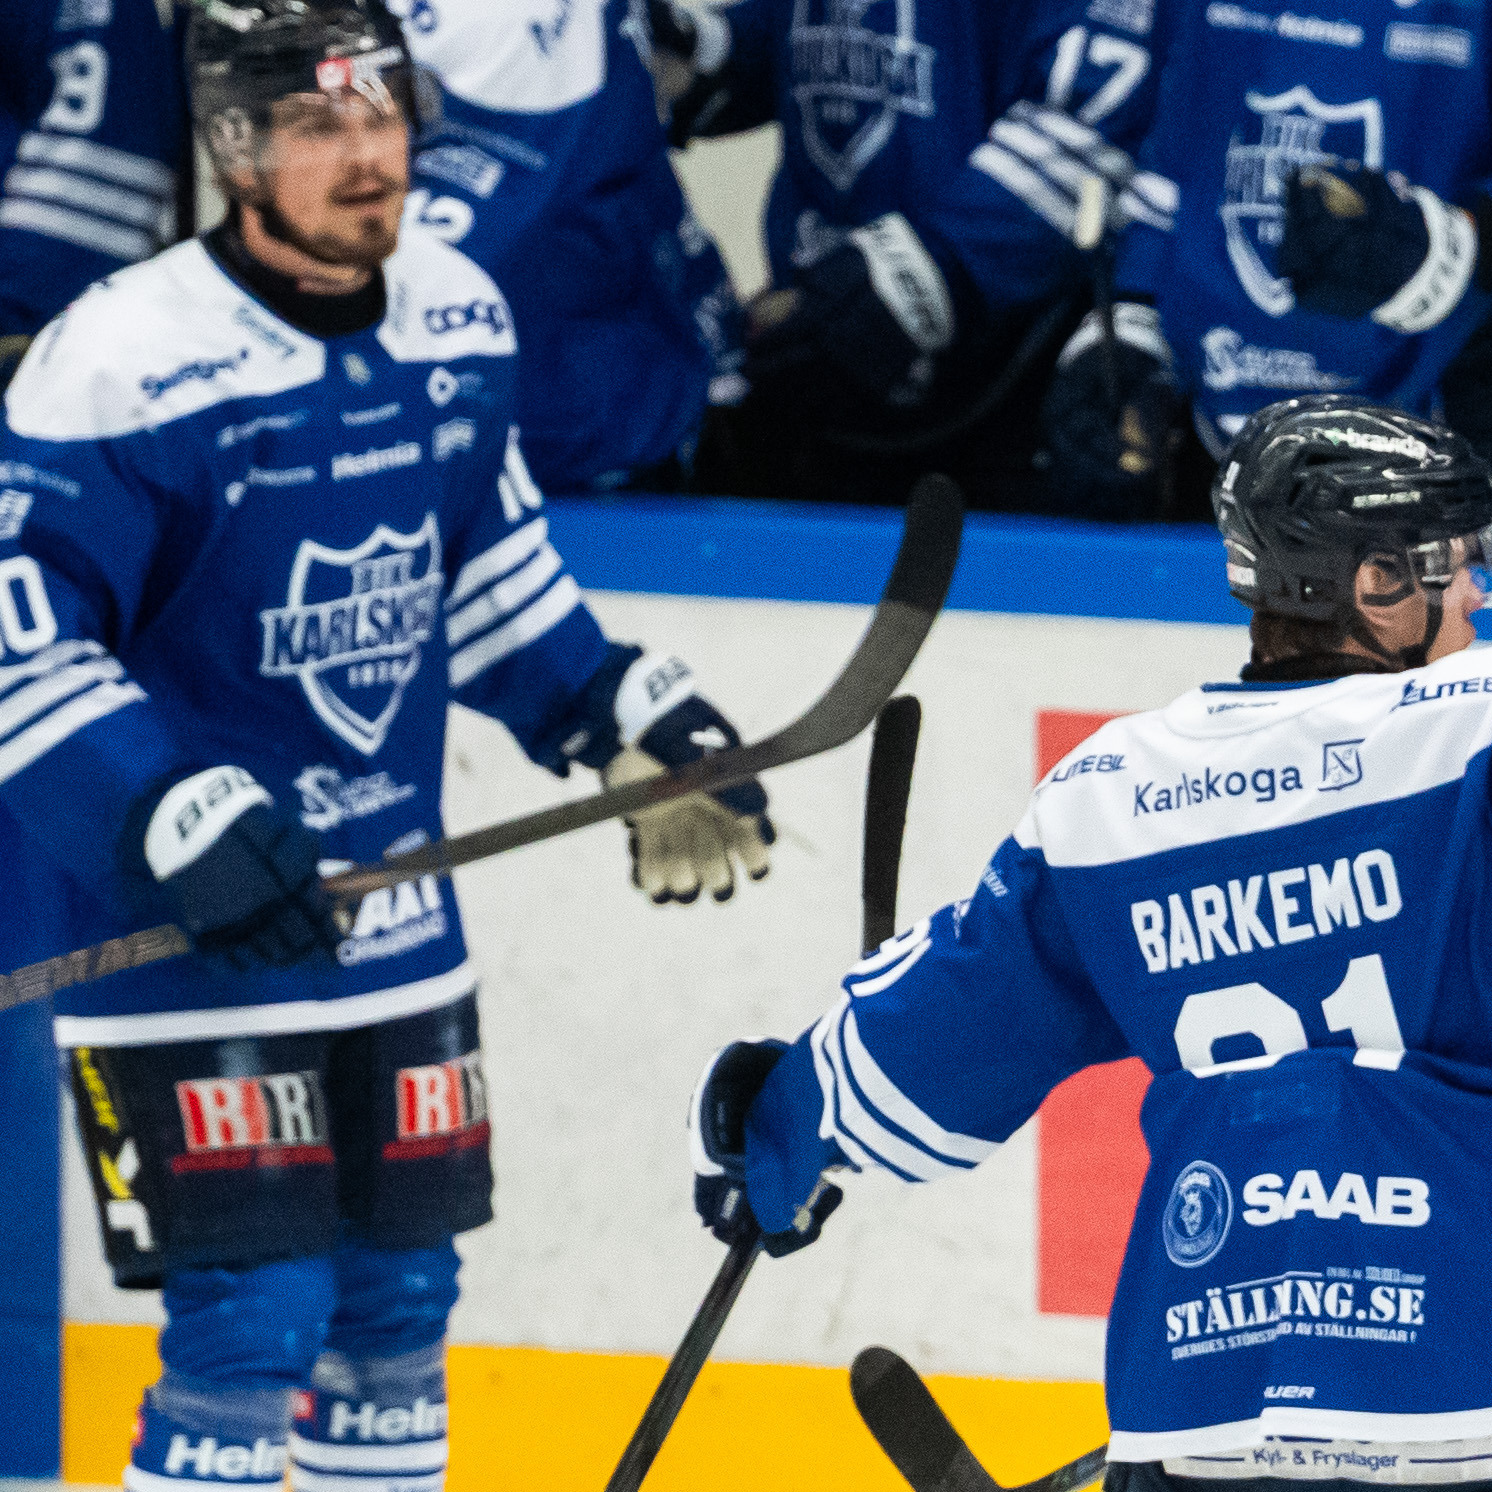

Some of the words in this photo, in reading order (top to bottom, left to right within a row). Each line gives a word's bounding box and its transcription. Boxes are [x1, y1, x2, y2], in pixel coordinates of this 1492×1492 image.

[1048, 24, 1150, 124] 17
[1133, 766, 1304, 818] Karlskoga
[1131, 849, 1402, 974] BARKEMO
[1242, 1169, 1431, 1227] SAAB
[1166, 1279, 1426, 1342] STÄLLING.SE
[1263, 1385, 1316, 1400] UER
[1292, 1450, 1306, 1466] &
